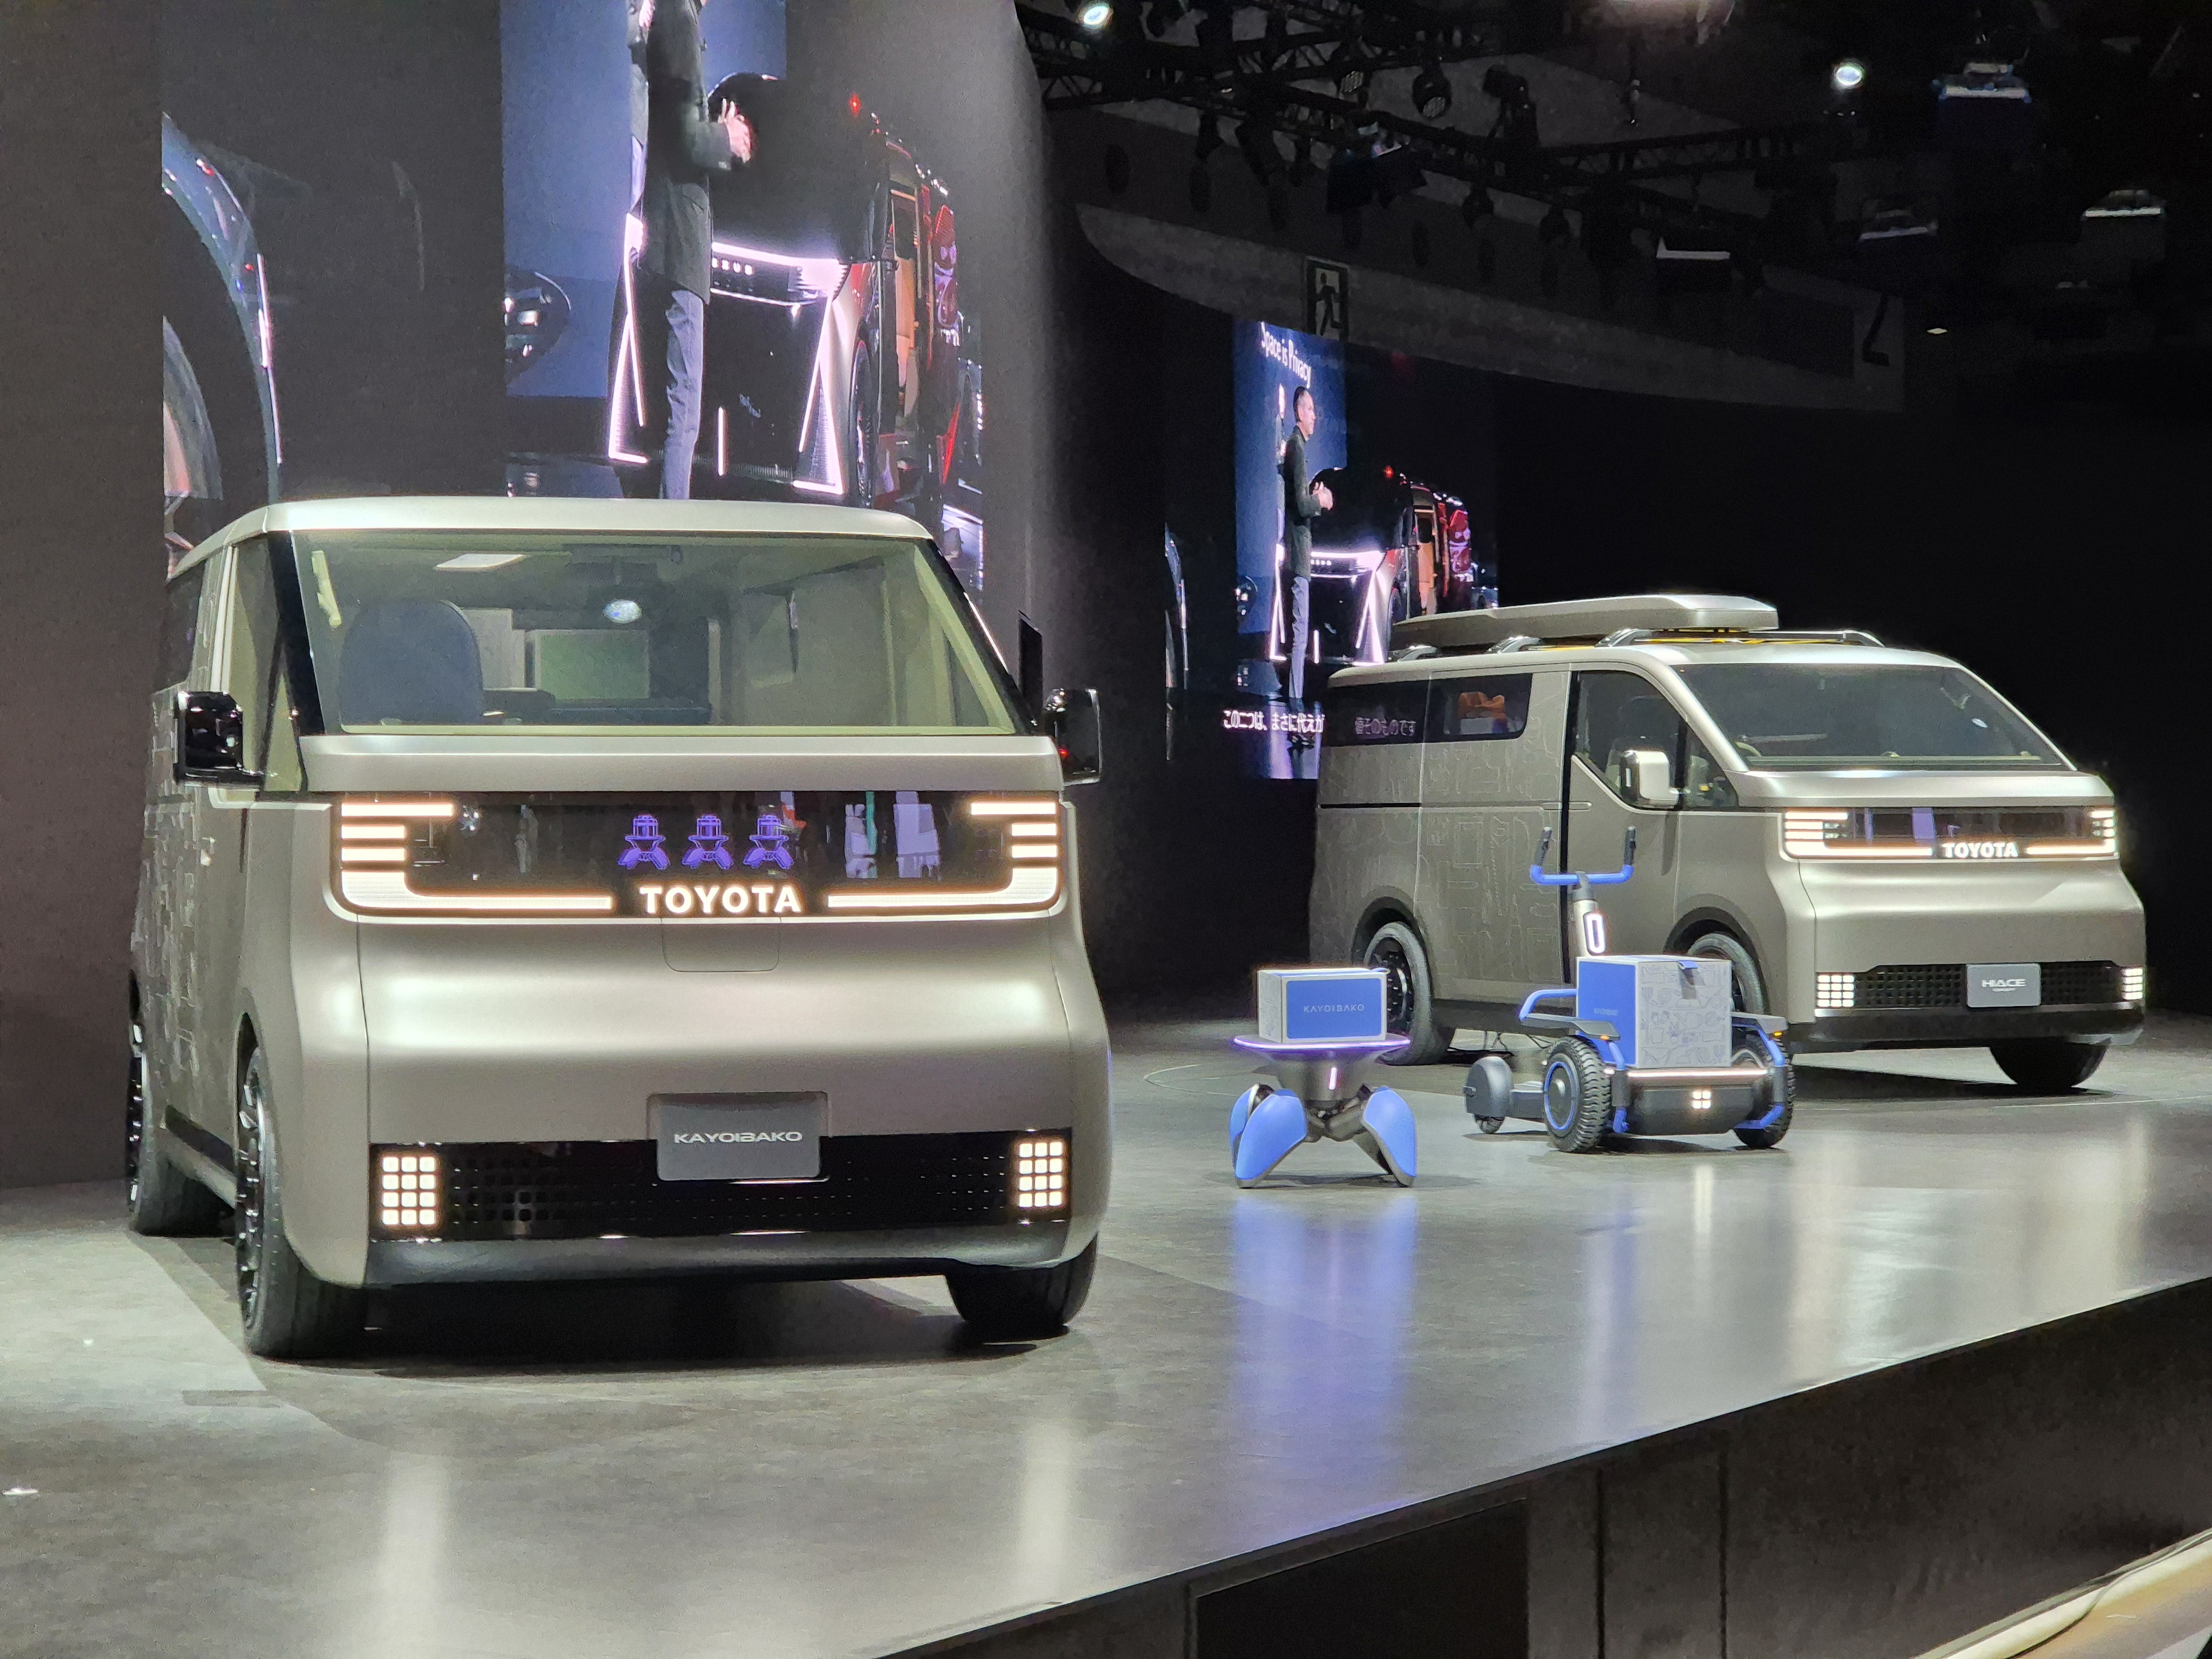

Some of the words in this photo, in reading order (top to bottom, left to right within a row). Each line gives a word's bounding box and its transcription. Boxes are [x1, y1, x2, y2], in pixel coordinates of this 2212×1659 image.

[1260, 321, 1281, 361] Space
[1281, 338, 1288, 367] is
[1288, 338, 1312, 389] Privacy
[1942, 842, 2018, 858] TOYOTA
[639, 886, 801, 914] TOYOTA
[1982, 979, 2027, 988] HIACE
[1303, 1004, 1364, 1013] KAYOIBAKO
[674, 1131, 802, 1144] KAYOIBAKO
